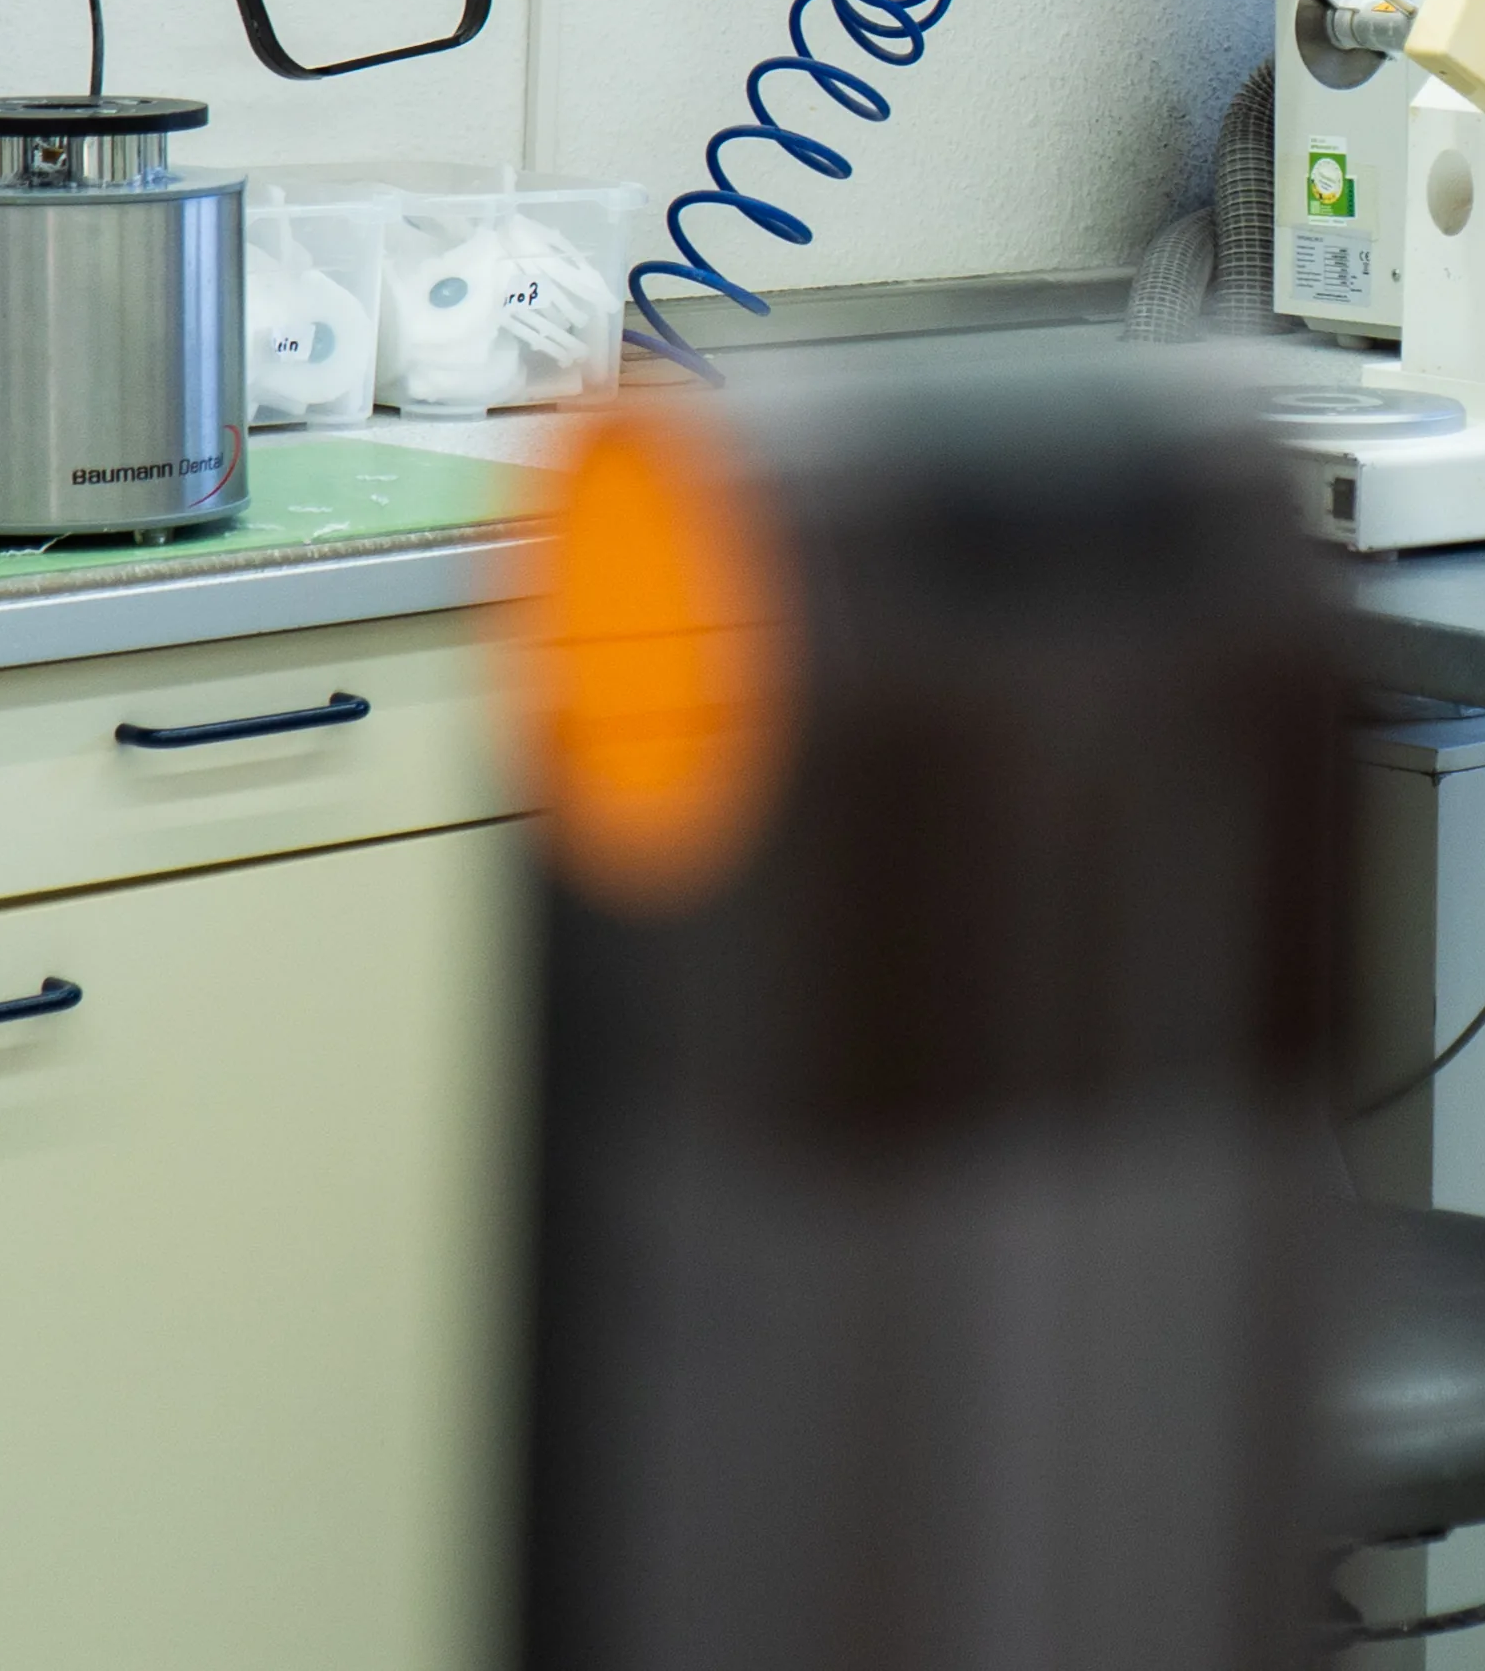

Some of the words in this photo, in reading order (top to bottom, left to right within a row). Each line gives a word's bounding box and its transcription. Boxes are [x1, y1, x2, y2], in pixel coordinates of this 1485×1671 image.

[503, 282, 538, 307] roß
[72, 462, 173, 485] Baumann
[178, 452, 224, 476] Dental
